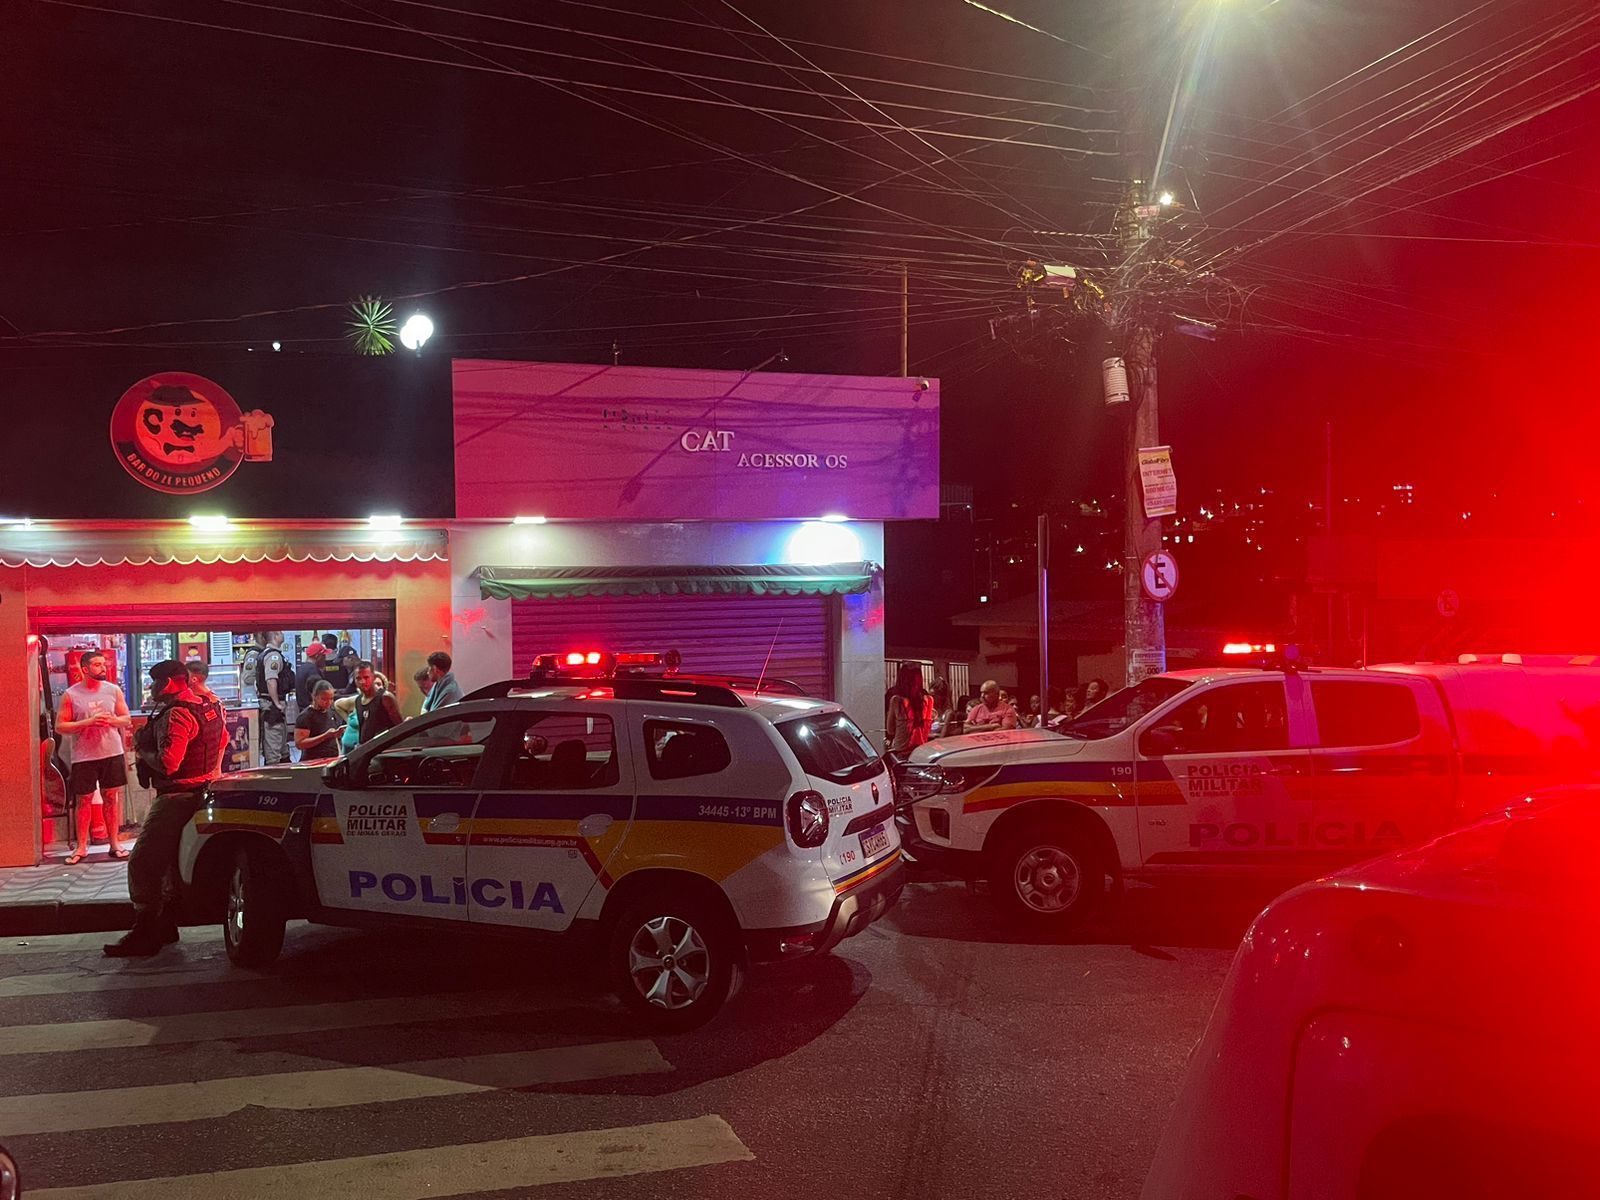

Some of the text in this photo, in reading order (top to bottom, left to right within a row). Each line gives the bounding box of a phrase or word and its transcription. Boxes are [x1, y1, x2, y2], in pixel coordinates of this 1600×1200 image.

[681, 431, 735, 452] CAT
[127, 454, 145, 472] BAR
[145, 469, 159, 481] DO
[175, 466, 221, 487] PEQUENO
[1154, 562, 1167, 589] E
[1111, 766, 1132, 776] 190
[1188, 778, 1262, 791] MILITAR
[258, 795, 278, 806] 190
[753, 806, 777, 819] BPM
[828, 803, 853, 814] MILITAR
[347, 819, 407, 831] MILITAR
[843, 850, 856, 864] 190
